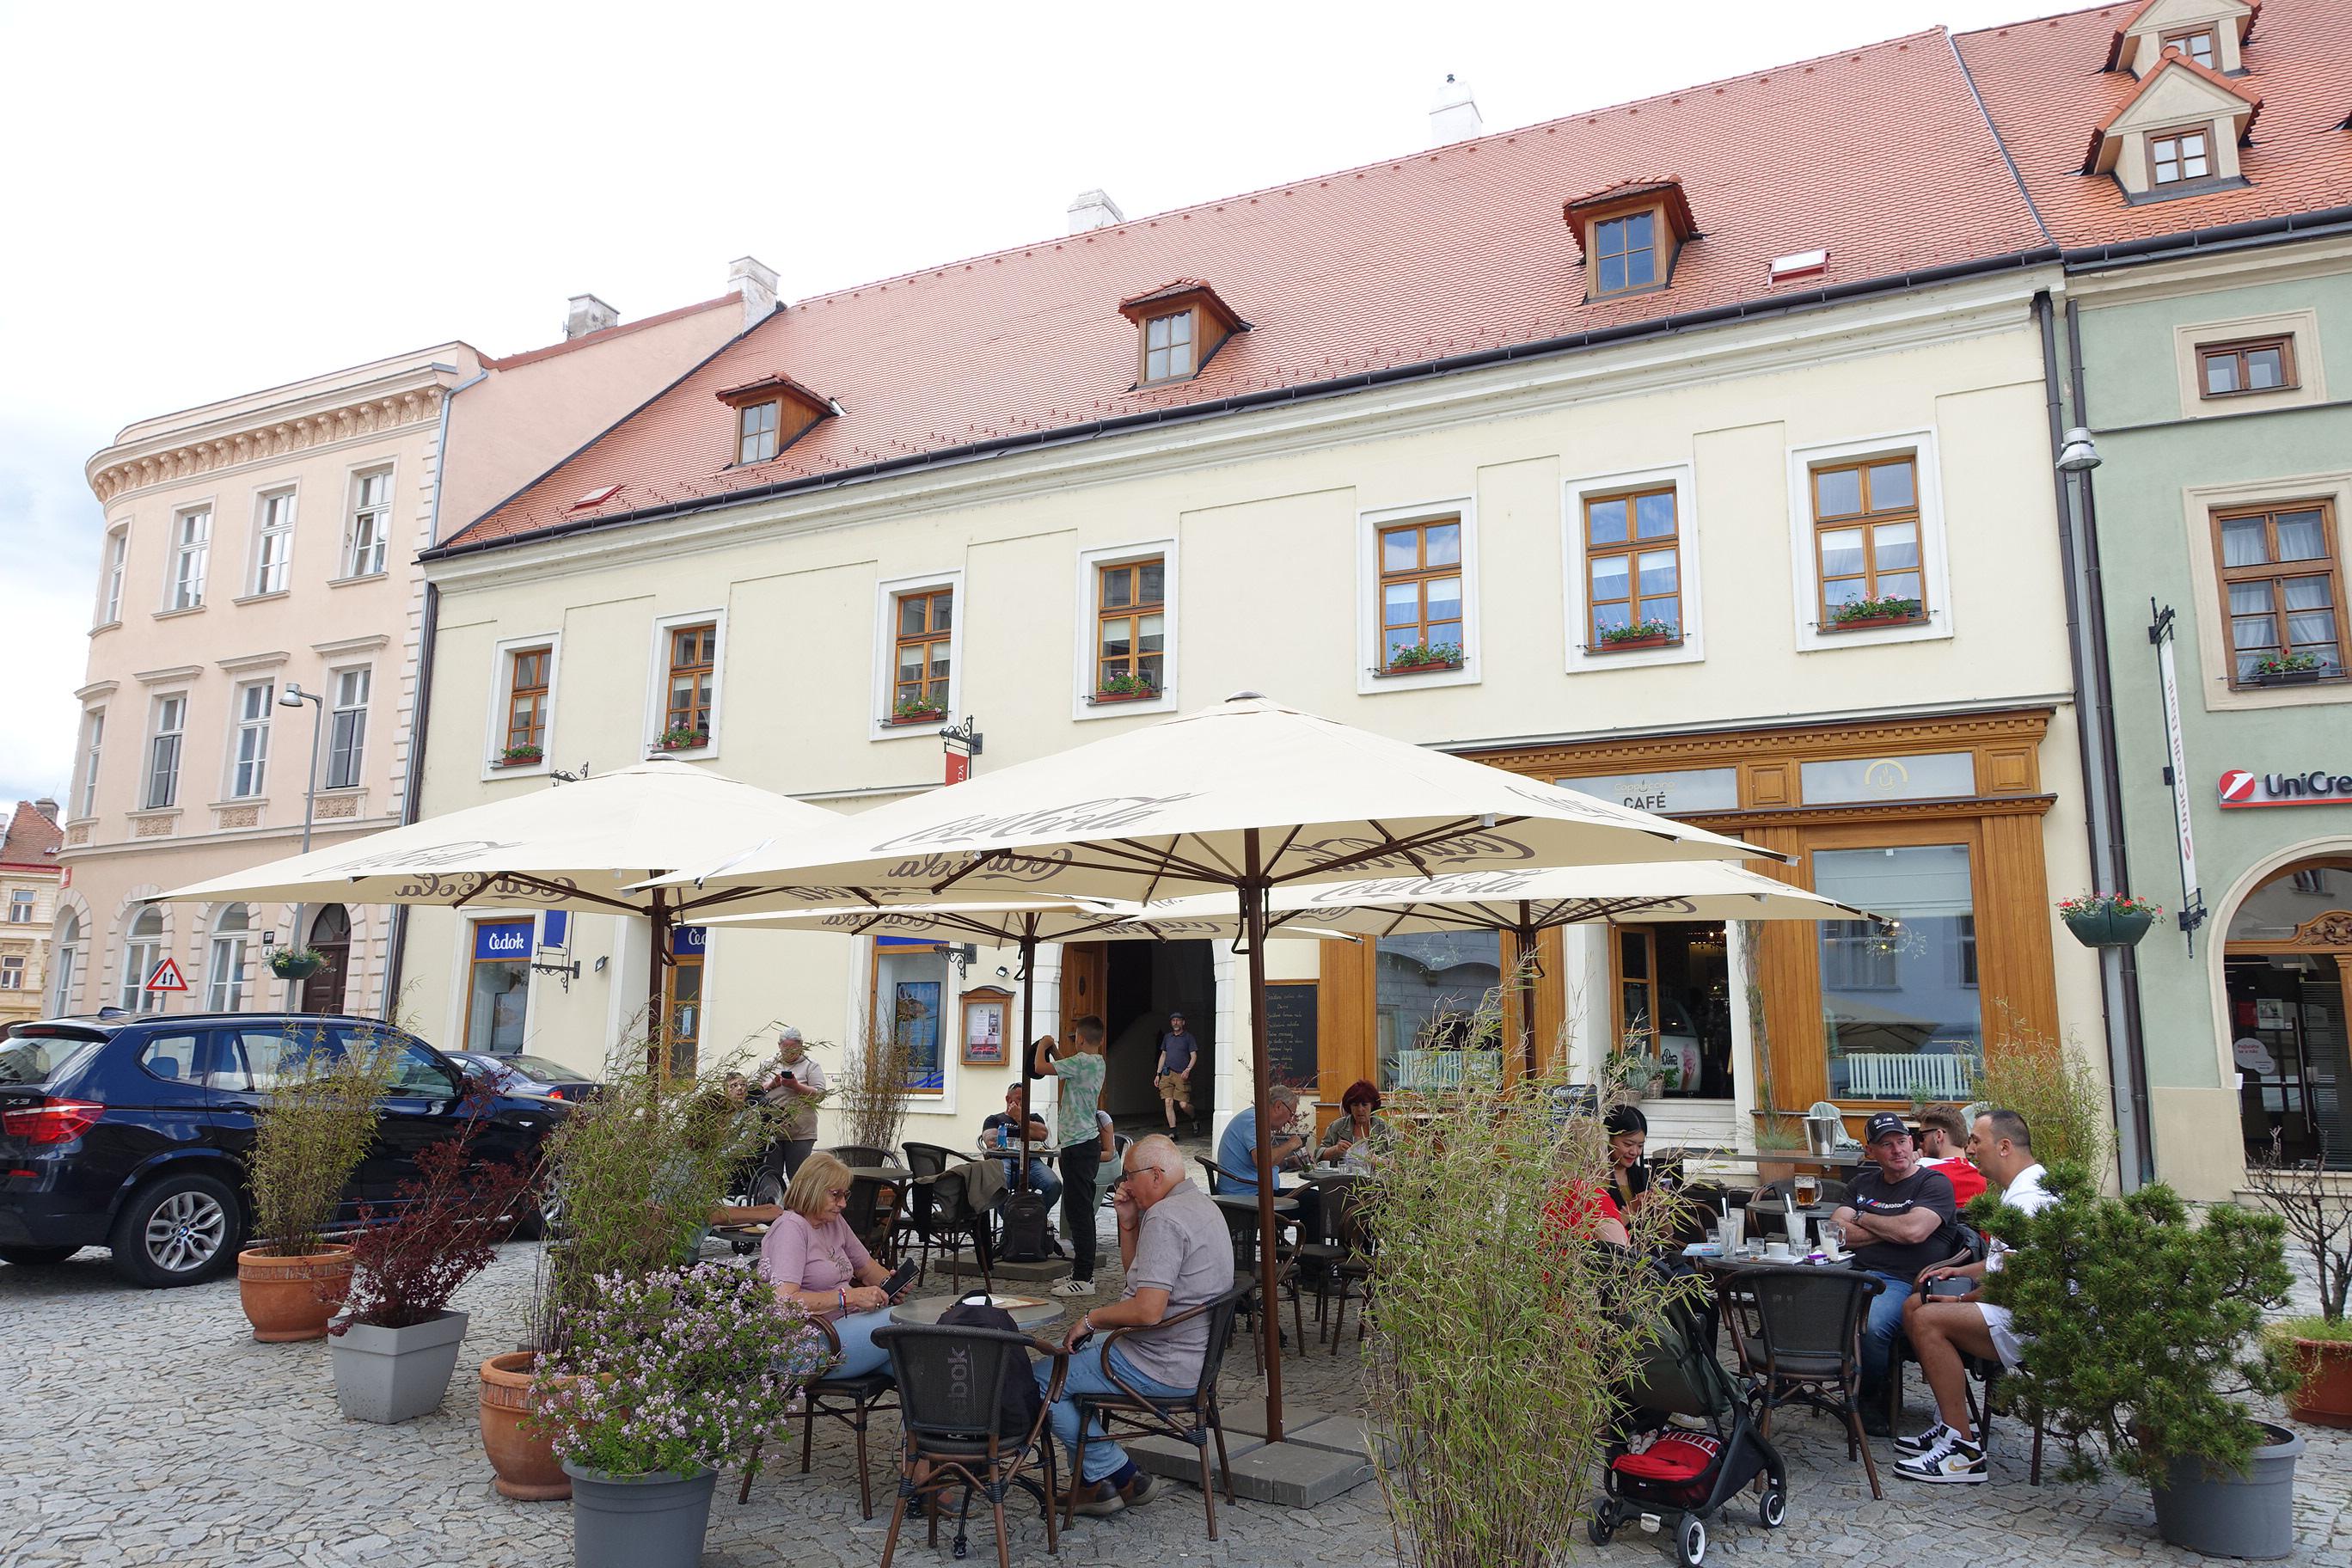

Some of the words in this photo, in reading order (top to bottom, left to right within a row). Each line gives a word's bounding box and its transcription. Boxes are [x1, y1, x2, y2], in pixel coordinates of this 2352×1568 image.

[2167, 675, 2178, 732] Bank
[2173, 734, 2188, 833] UniCredit
[2264, 771, 2352, 796] UniCre
[1623, 791, 1666, 809] CAFÉ
[489, 933, 524, 950] Čedok
